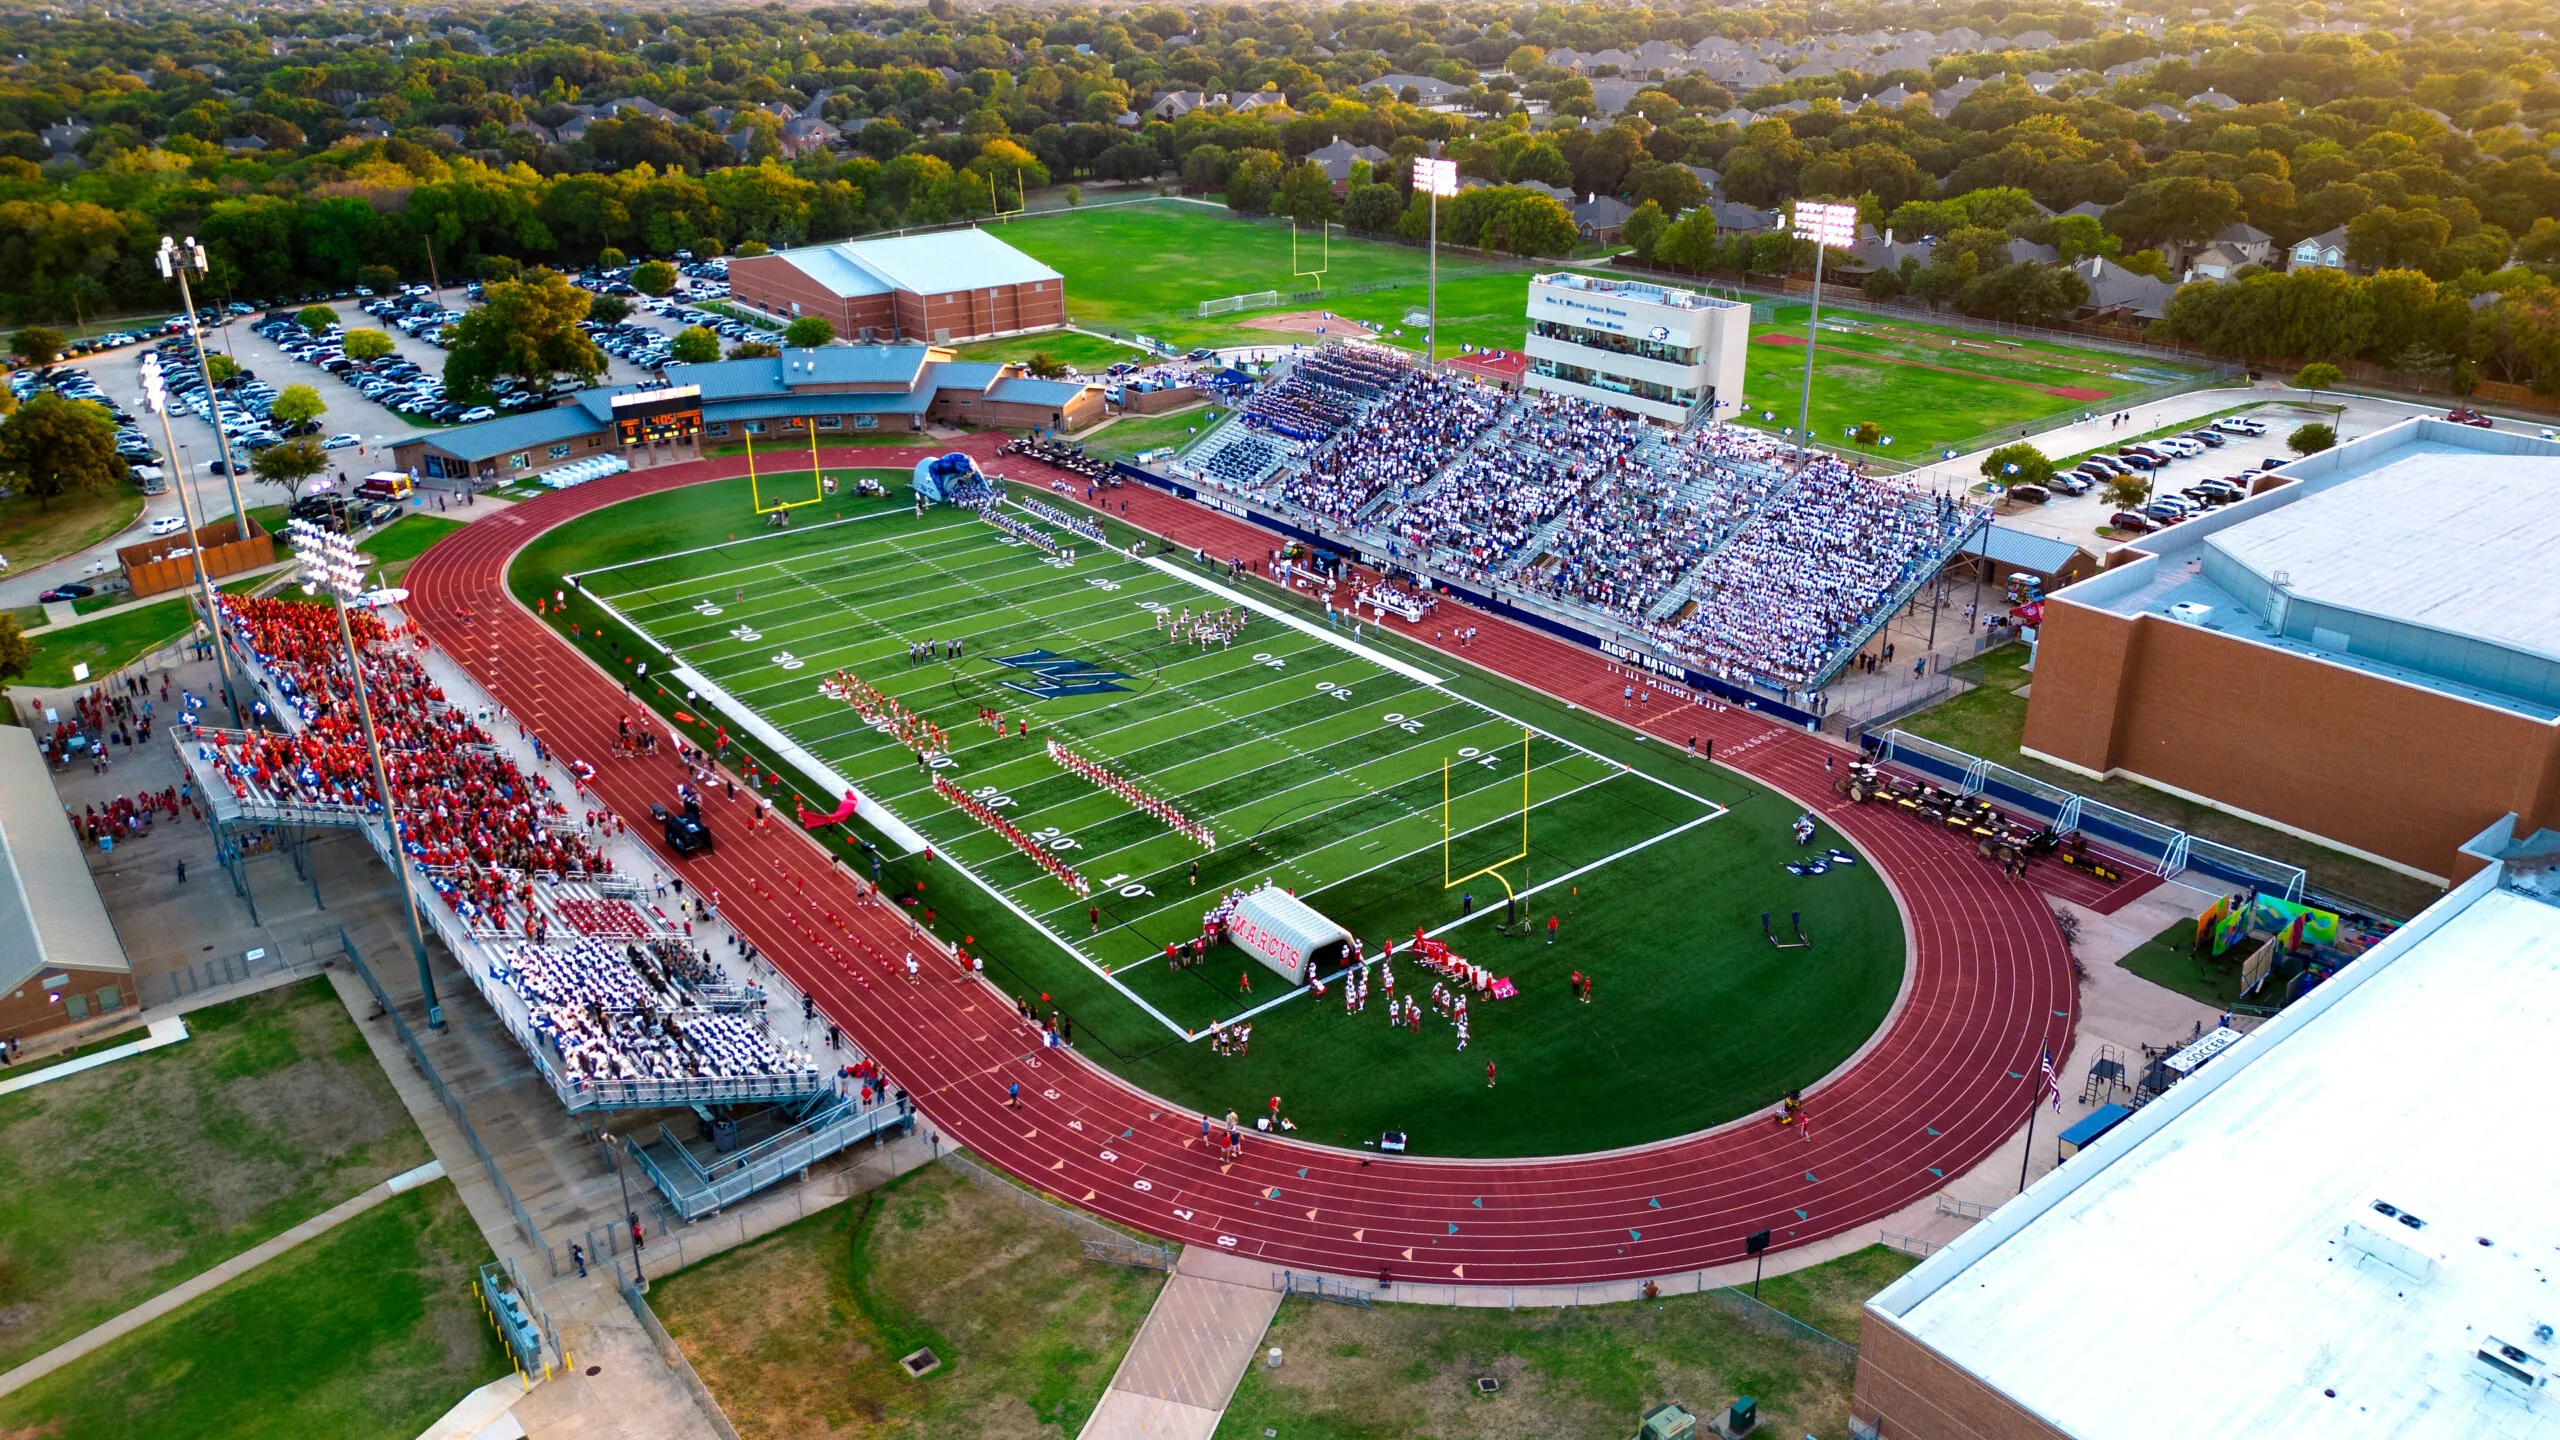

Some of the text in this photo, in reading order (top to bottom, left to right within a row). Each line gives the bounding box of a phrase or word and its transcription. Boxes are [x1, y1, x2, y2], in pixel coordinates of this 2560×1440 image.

[1196, 491, 1248, 519] JAGUAR NATION
[692, 601, 724, 616] 10
[729, 625, 763, 642] 20
[771, 652, 805, 670] 30
[1252, 653, 1286, 669] 40
[1600, 640, 1685, 680] JAGUAR NATION
[1315, 682, 1353, 700] 30
[1383, 712, 1425, 732] 20
[1458, 746, 1502, 768] 10
[971, 786, 1012, 808] 30
[1031, 826, 1076, 850] 20
[1100, 872, 1147, 898] 10
[1232, 914, 1300, 971] MARCUS
[2186, 1038, 2229, 1064] SOCCER
[1025, 1057, 1042, 1068] 2
[1043, 1088, 1061, 1100] 3
[1067, 1120, 1084, 1132] 4
[1100, 1150, 1120, 1163] 5
[1133, 1179, 1153, 1192] 6
[1172, 1209, 1194, 1221] 7
[1216, 1235, 1238, 1247] 8
